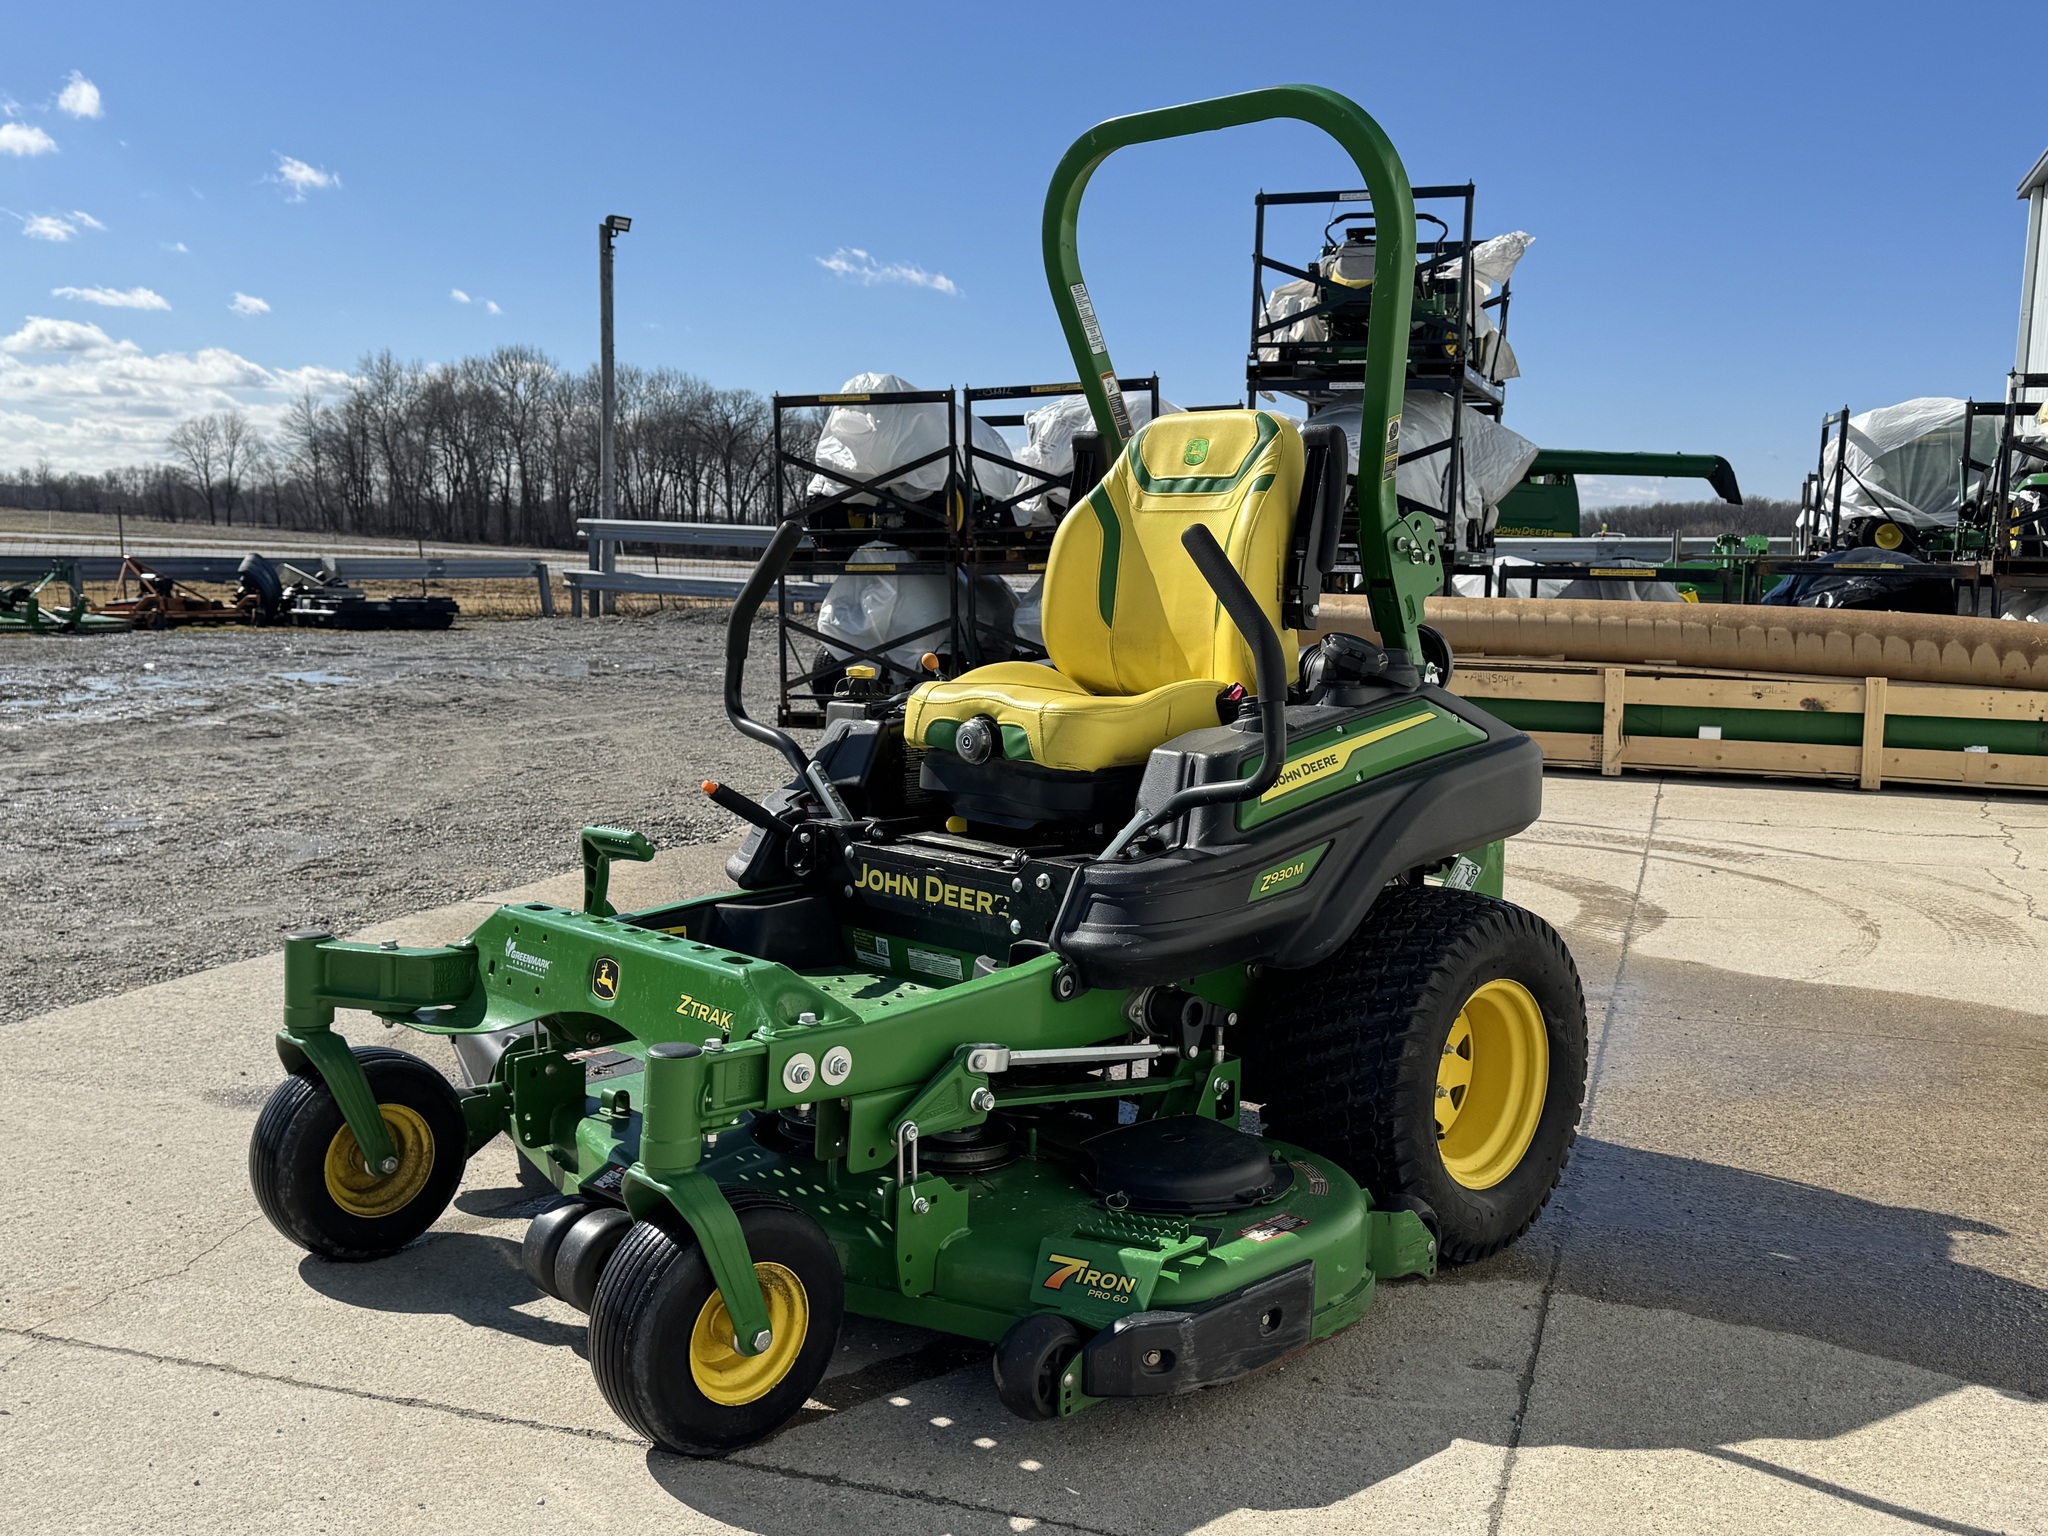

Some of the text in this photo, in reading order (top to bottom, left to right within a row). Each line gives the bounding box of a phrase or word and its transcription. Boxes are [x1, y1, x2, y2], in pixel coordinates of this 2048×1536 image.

[1497, 525, 1554, 537] JOHN DEERE
[1301, 754, 1339, 776] DEERE
[855, 863, 918, 899] JOHN
[1260, 862, 1305, 892] Z930M
[510, 950, 550, 970] GREENMARK
[676, 993, 734, 1029] ZTRAK
[1087, 1289, 1129, 1304] PRO 60
